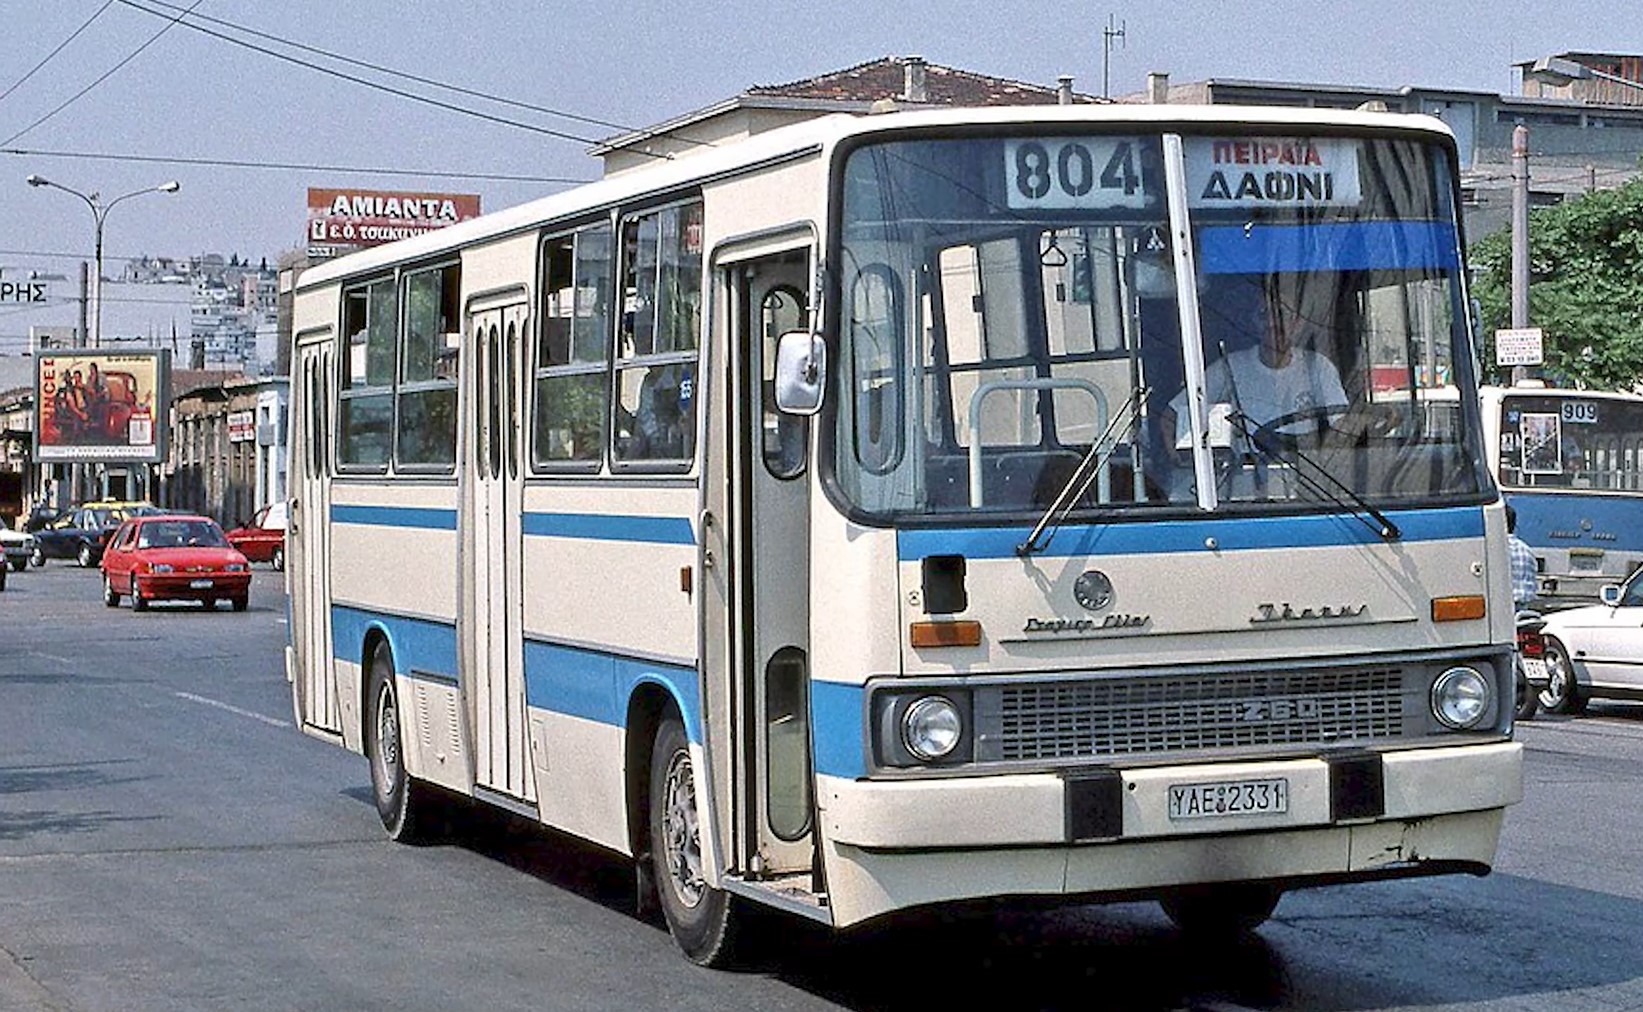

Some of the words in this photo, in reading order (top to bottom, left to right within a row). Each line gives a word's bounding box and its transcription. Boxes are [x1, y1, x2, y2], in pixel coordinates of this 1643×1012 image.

[1016, 141, 1140, 200] 804
[1201, 170, 1333, 201] ΔΑΦΝΙ
[329, 195, 459, 221] ΑΜΙΑΝΤΑ
[1, 282, 47, 302] ΡΗΣ
[1563, 404, 1597, 420] 909
